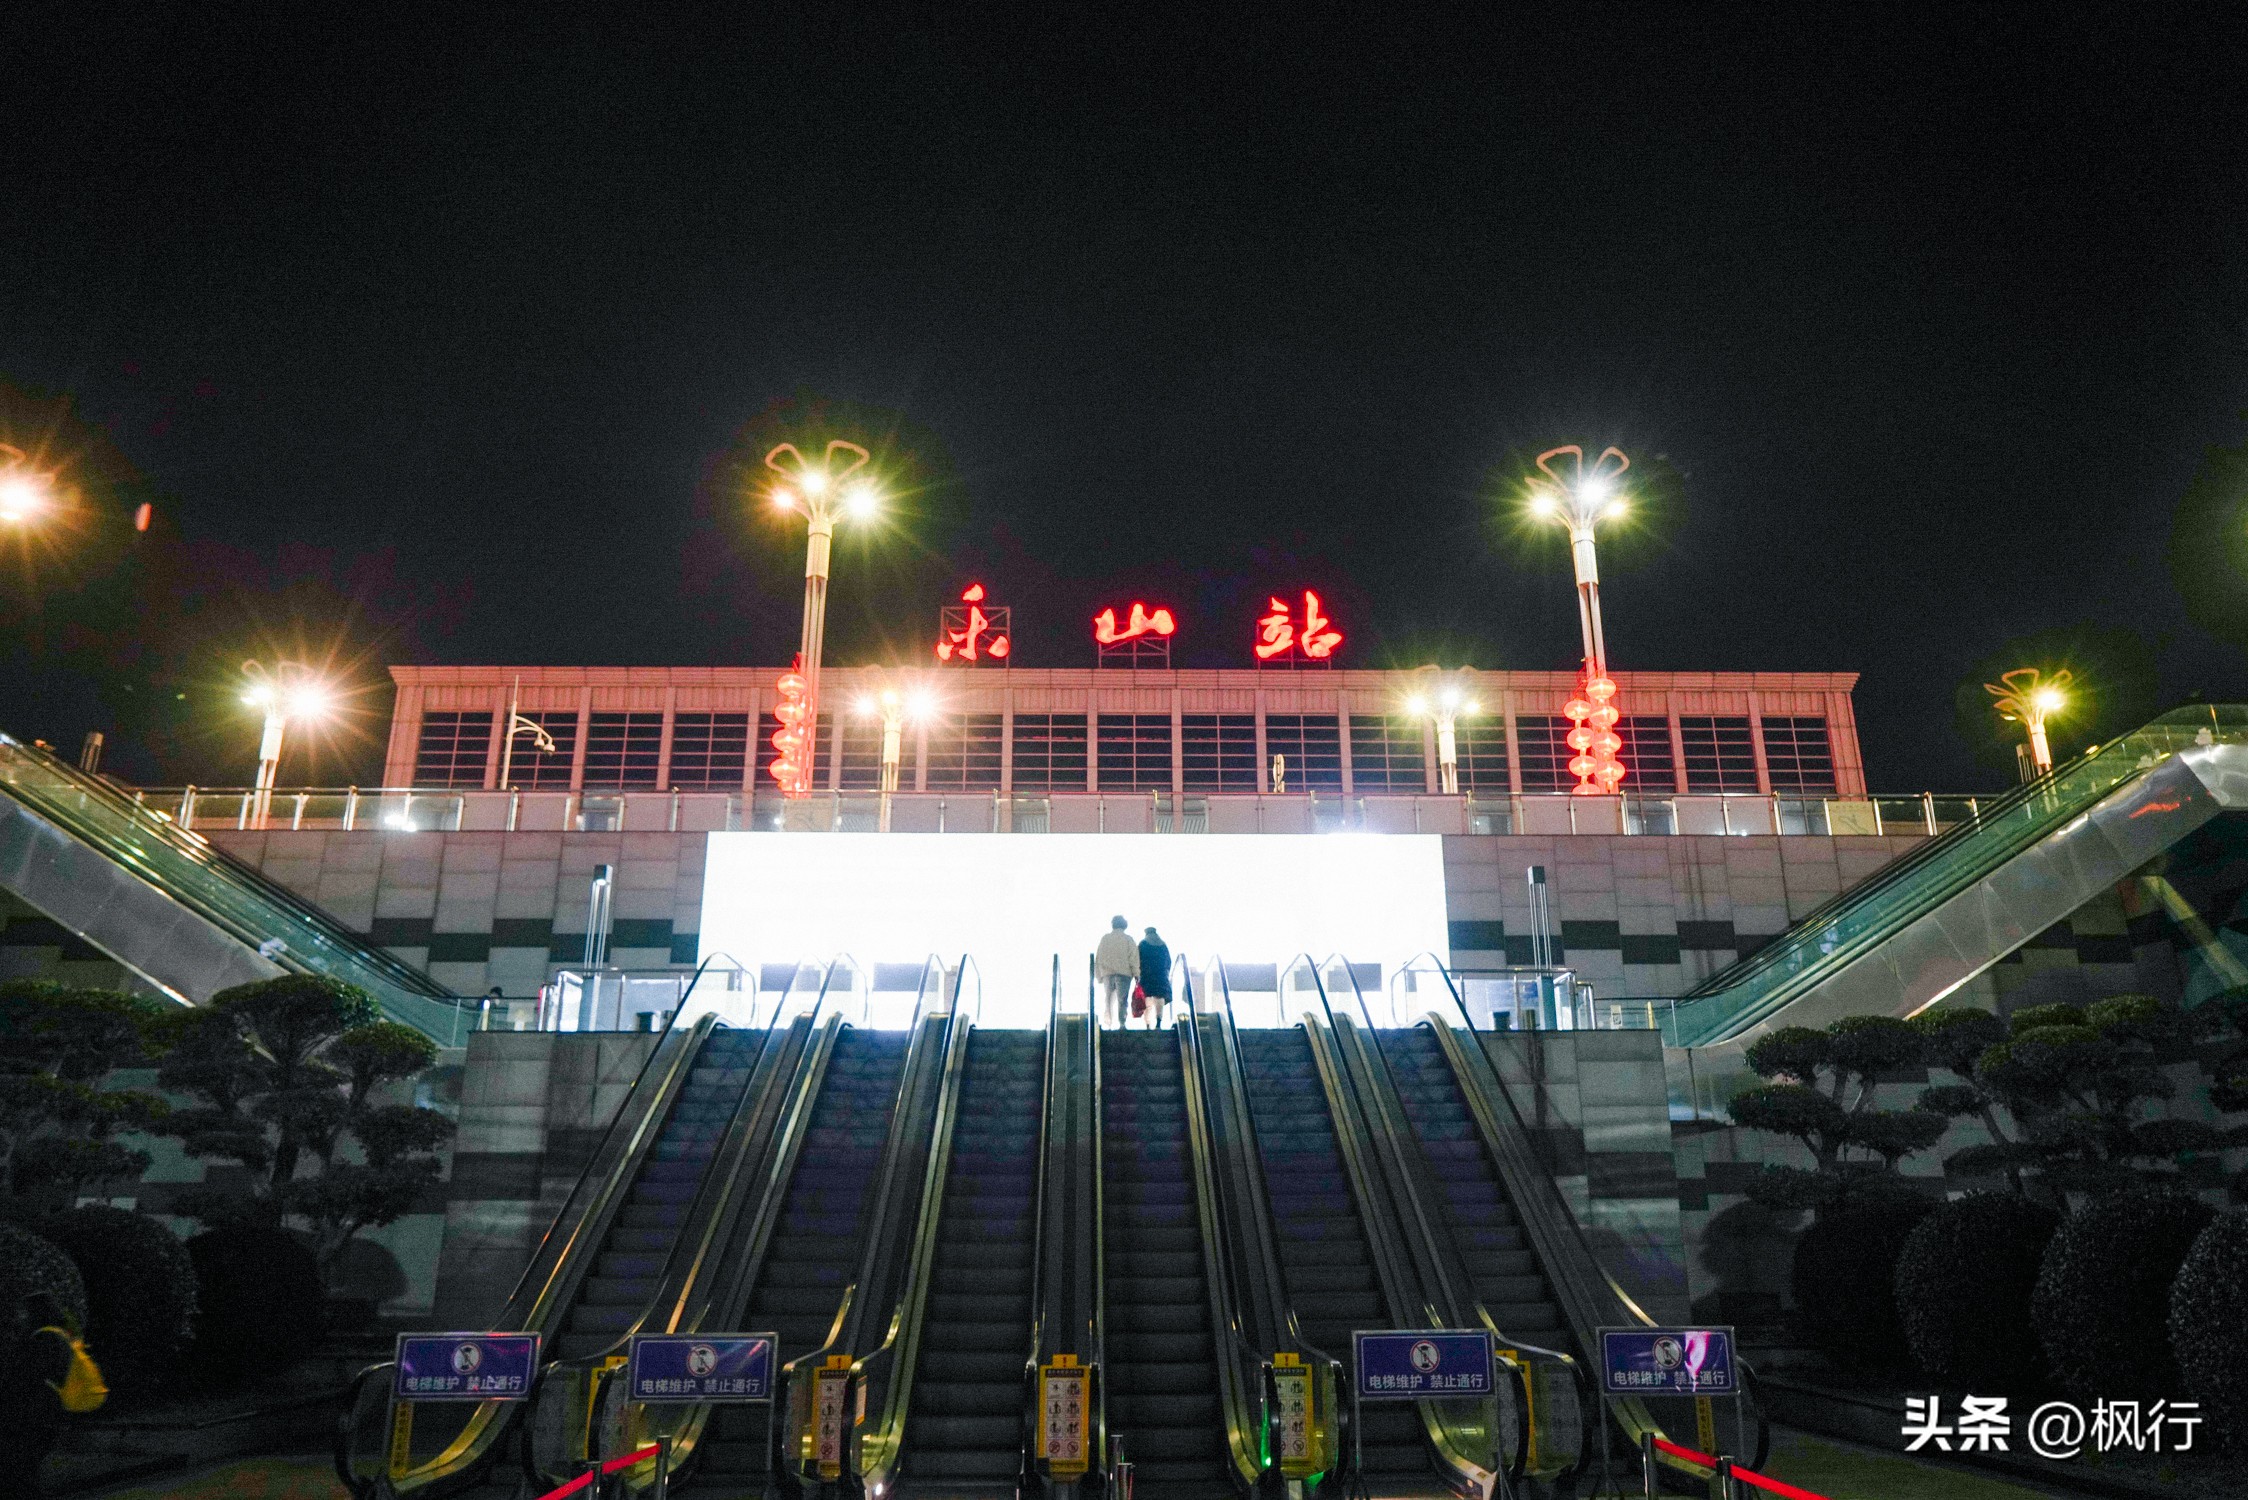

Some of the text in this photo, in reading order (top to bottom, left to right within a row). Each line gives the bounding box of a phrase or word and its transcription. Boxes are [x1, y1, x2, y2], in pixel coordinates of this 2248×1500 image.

[406, 1375, 523, 1391] 电梯维护 禁止通行
[641, 1377, 761, 1393] 电梯维护 禁止通行
[1369, 1374, 1483, 1389] 电梯维护 禁止通行
[1614, 1370, 1725, 1386] 电梯维护 禁止通行
